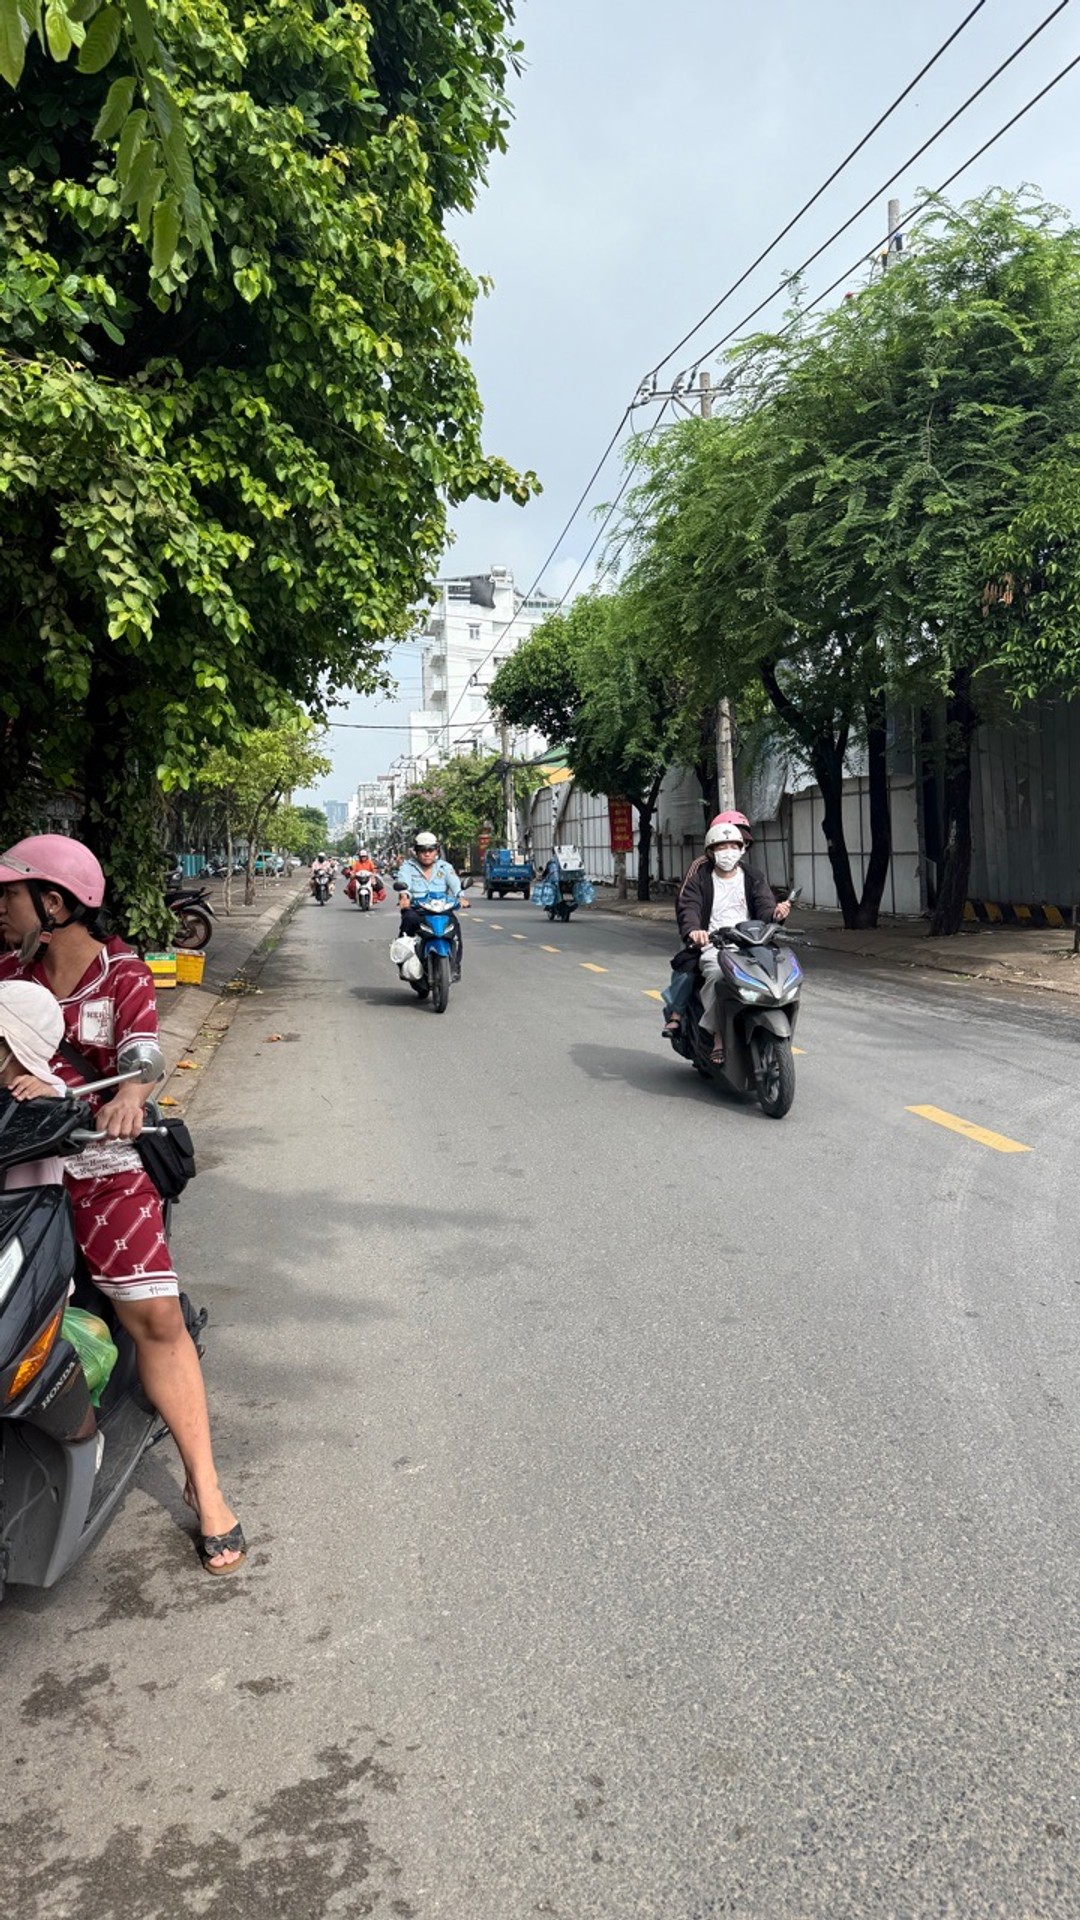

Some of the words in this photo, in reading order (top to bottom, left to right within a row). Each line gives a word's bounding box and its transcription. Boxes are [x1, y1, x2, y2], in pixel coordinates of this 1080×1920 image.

[140, 1207, 152, 1218] H
[95, 1215, 108, 1226] H
[114, 1240, 128, 1251] H
[41, 1361, 76, 1410] HONDA
